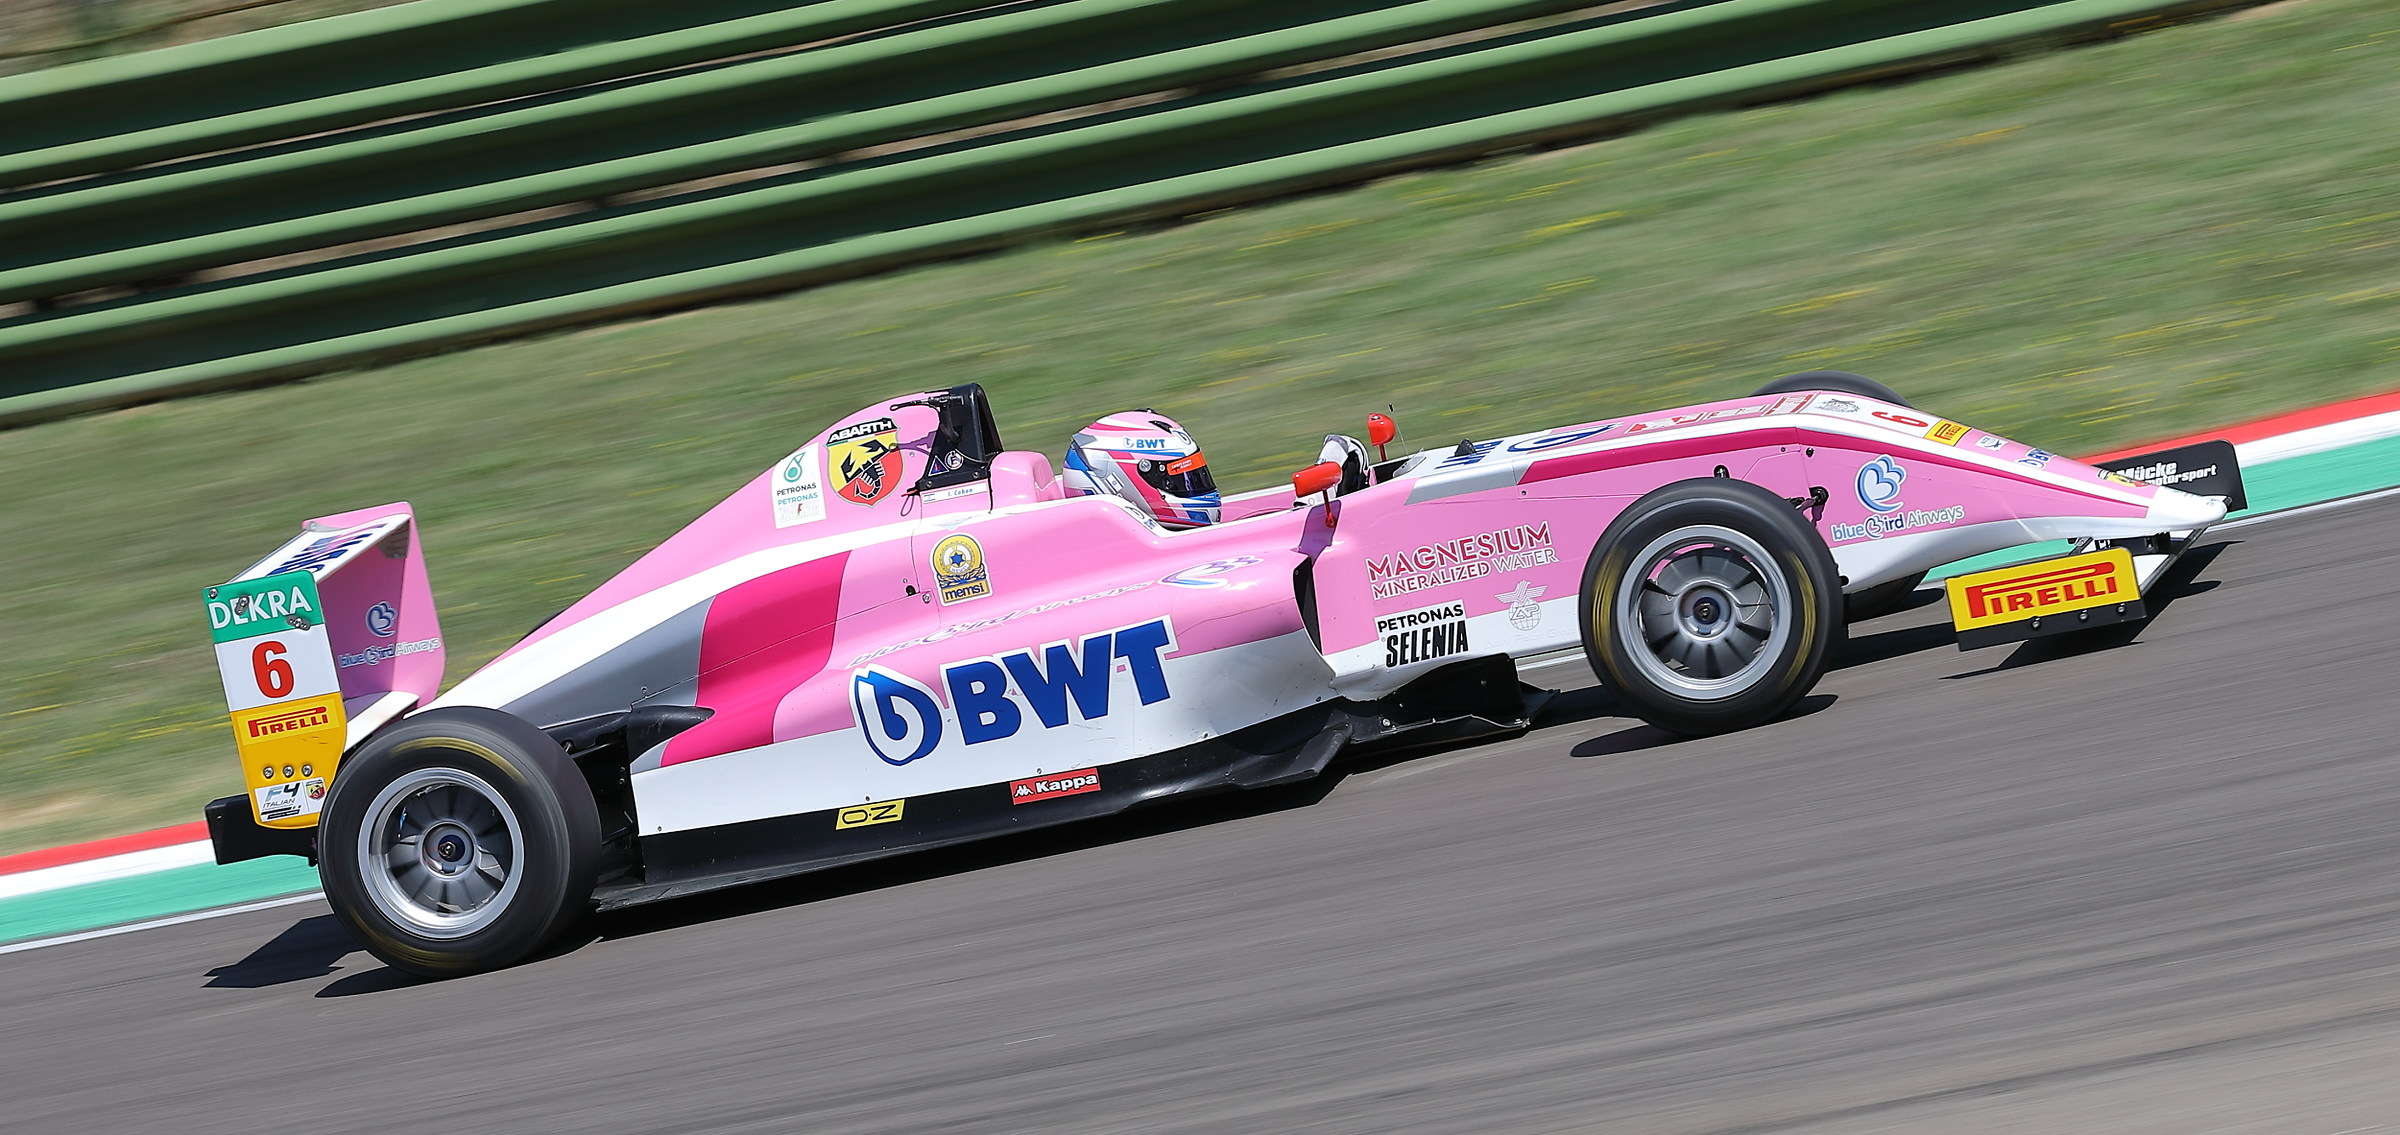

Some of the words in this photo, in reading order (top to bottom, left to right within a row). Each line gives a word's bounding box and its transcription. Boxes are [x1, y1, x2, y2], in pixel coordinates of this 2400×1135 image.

[1871, 411, 1929, 428] 6
[829, 420, 893, 443] ABARTH
[1934, 422, 1963, 441] PIRELLI
[1136, 439, 1165, 448] BWT
[776, 483, 817, 496] PETRONAS
[777, 492, 818, 505] PETRONAS
[954, 488, 973, 496] Cohen
[1907, 505, 1964, 527] Airways
[1366, 521, 1551, 582] MAGNESIUM
[1371, 562, 1490, 599] MINERALIZED
[1494, 549, 1559, 574] WATER
[945, 583, 985, 600] memsi
[1965, 561, 2119, 620] PIRELLI
[207, 586, 312, 630] DEKRA
[1377, 604, 1464, 633] PETRONAS
[396, 638, 441, 657] Airways
[1386, 620, 1469, 668] SELENIA
[251, 641, 295, 699] 6
[945, 619, 1171, 746] BWT
[248, 706, 329, 738] PIRELLI
[265, 783, 301, 802] F4
[1035, 773, 1099, 794] Kappa
[262, 798, 296, 809] ITALIAN
